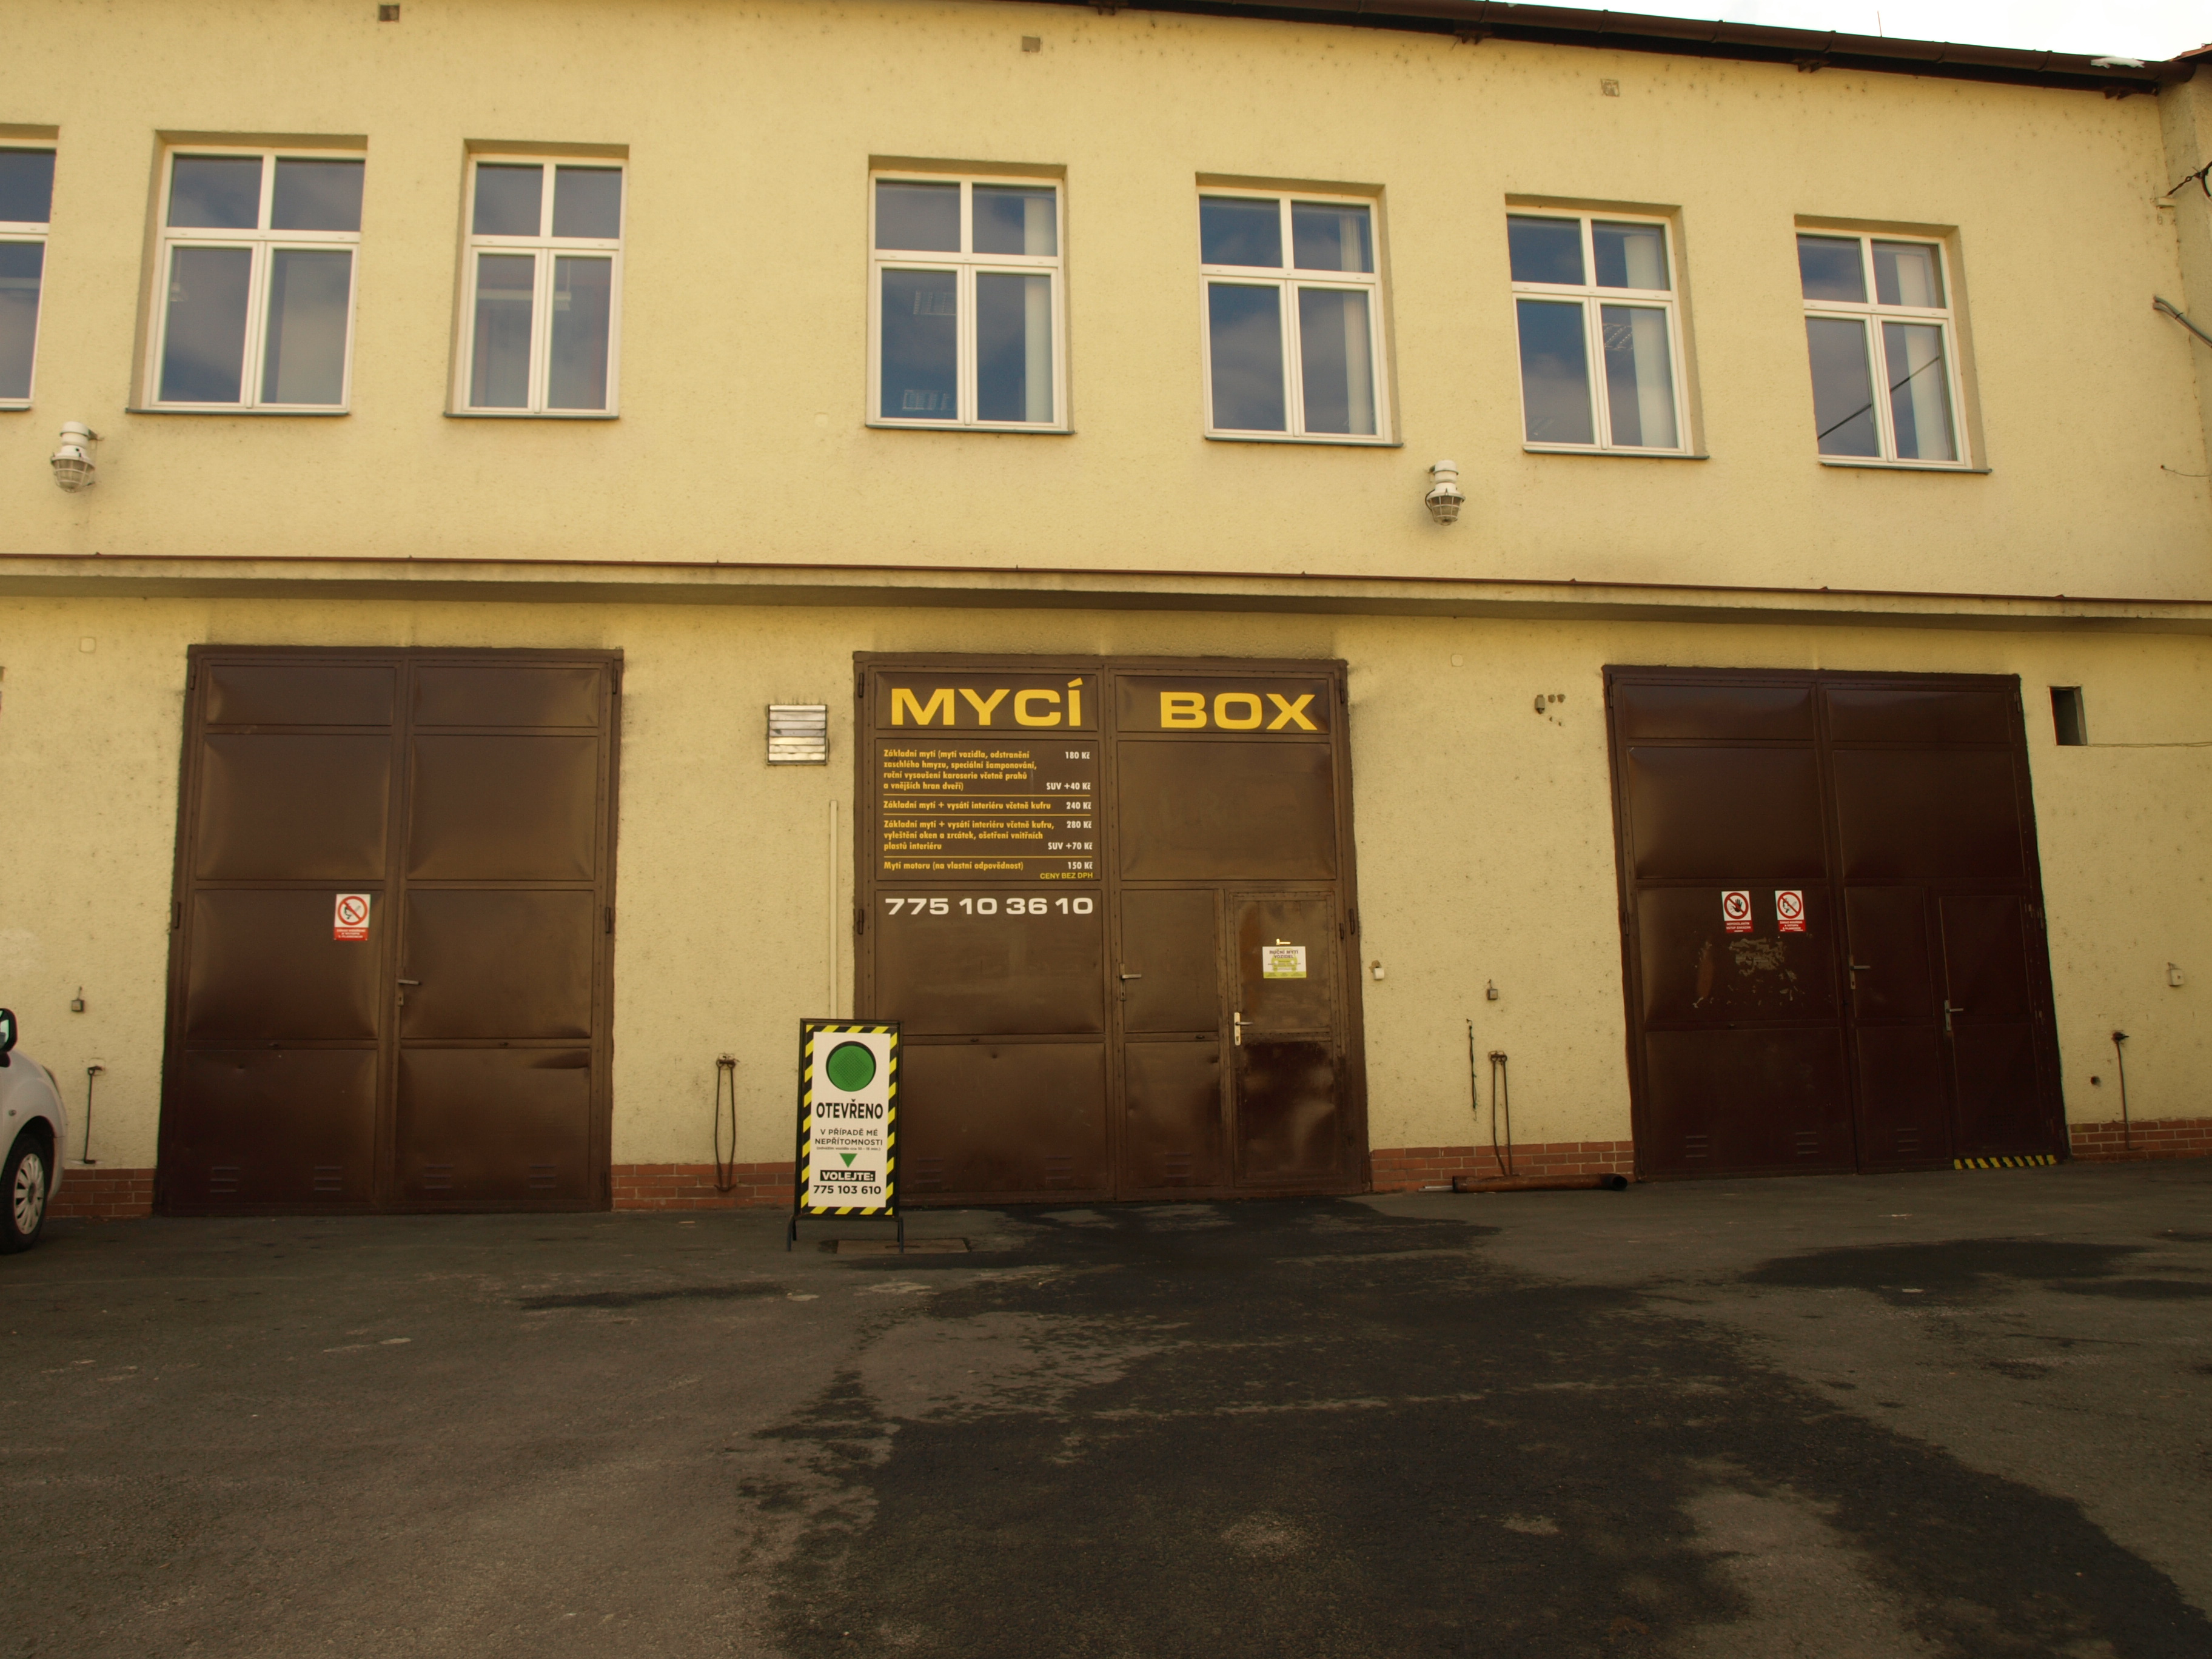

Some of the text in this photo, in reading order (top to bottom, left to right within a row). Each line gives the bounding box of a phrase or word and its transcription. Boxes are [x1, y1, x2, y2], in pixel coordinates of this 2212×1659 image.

[891, 678, 1317, 730] MYCÍ BOX
[919, 750, 936, 759] mytí
[938, 750, 957, 759] (mytí
[959, 751, 988, 759] vozidla,
[922, 760, 949, 769] hmyzu,
[951, 761, 984, 769] speciální
[986, 761, 1037, 770] šamponování,
[905, 771, 940, 780] vysoušení
[1005, 771, 1028, 781] prahů
[891, 782, 920, 791] vnějších
[942, 782, 964, 791] dveří)
[883, 800, 917, 809] Základní
[919, 801, 936, 810] mytí
[947, 801, 970, 811] vysátí
[971, 801, 1004, 809] interiéru
[884, 820, 917, 828] Základní
[920, 820, 936, 830] mytí
[948, 820, 970, 830] vysátí
[1032, 821, 1054, 830] kufru,
[884, 831, 917, 840] vyleštění
[947, 831, 976, 840] zrcátek,
[884, 841, 942, 851] plastů interiéru
[933, 861, 945, 871] (na
[947, 861, 972, 870] vlastní
[974, 861, 1024, 871] odpovědnost)
[885, 897, 1093, 914] 775 10 36 10
[816, 1099, 883, 1119] OTEVŘENO
[828, 1127, 864, 1136] PŘÍPADĚ
[815, 1137, 882, 1145] NEPŘÍTOMNOSTI
[822, 1171, 873, 1181] VOLEJTE:
[814, 1185, 881, 1195] 775 103 610
